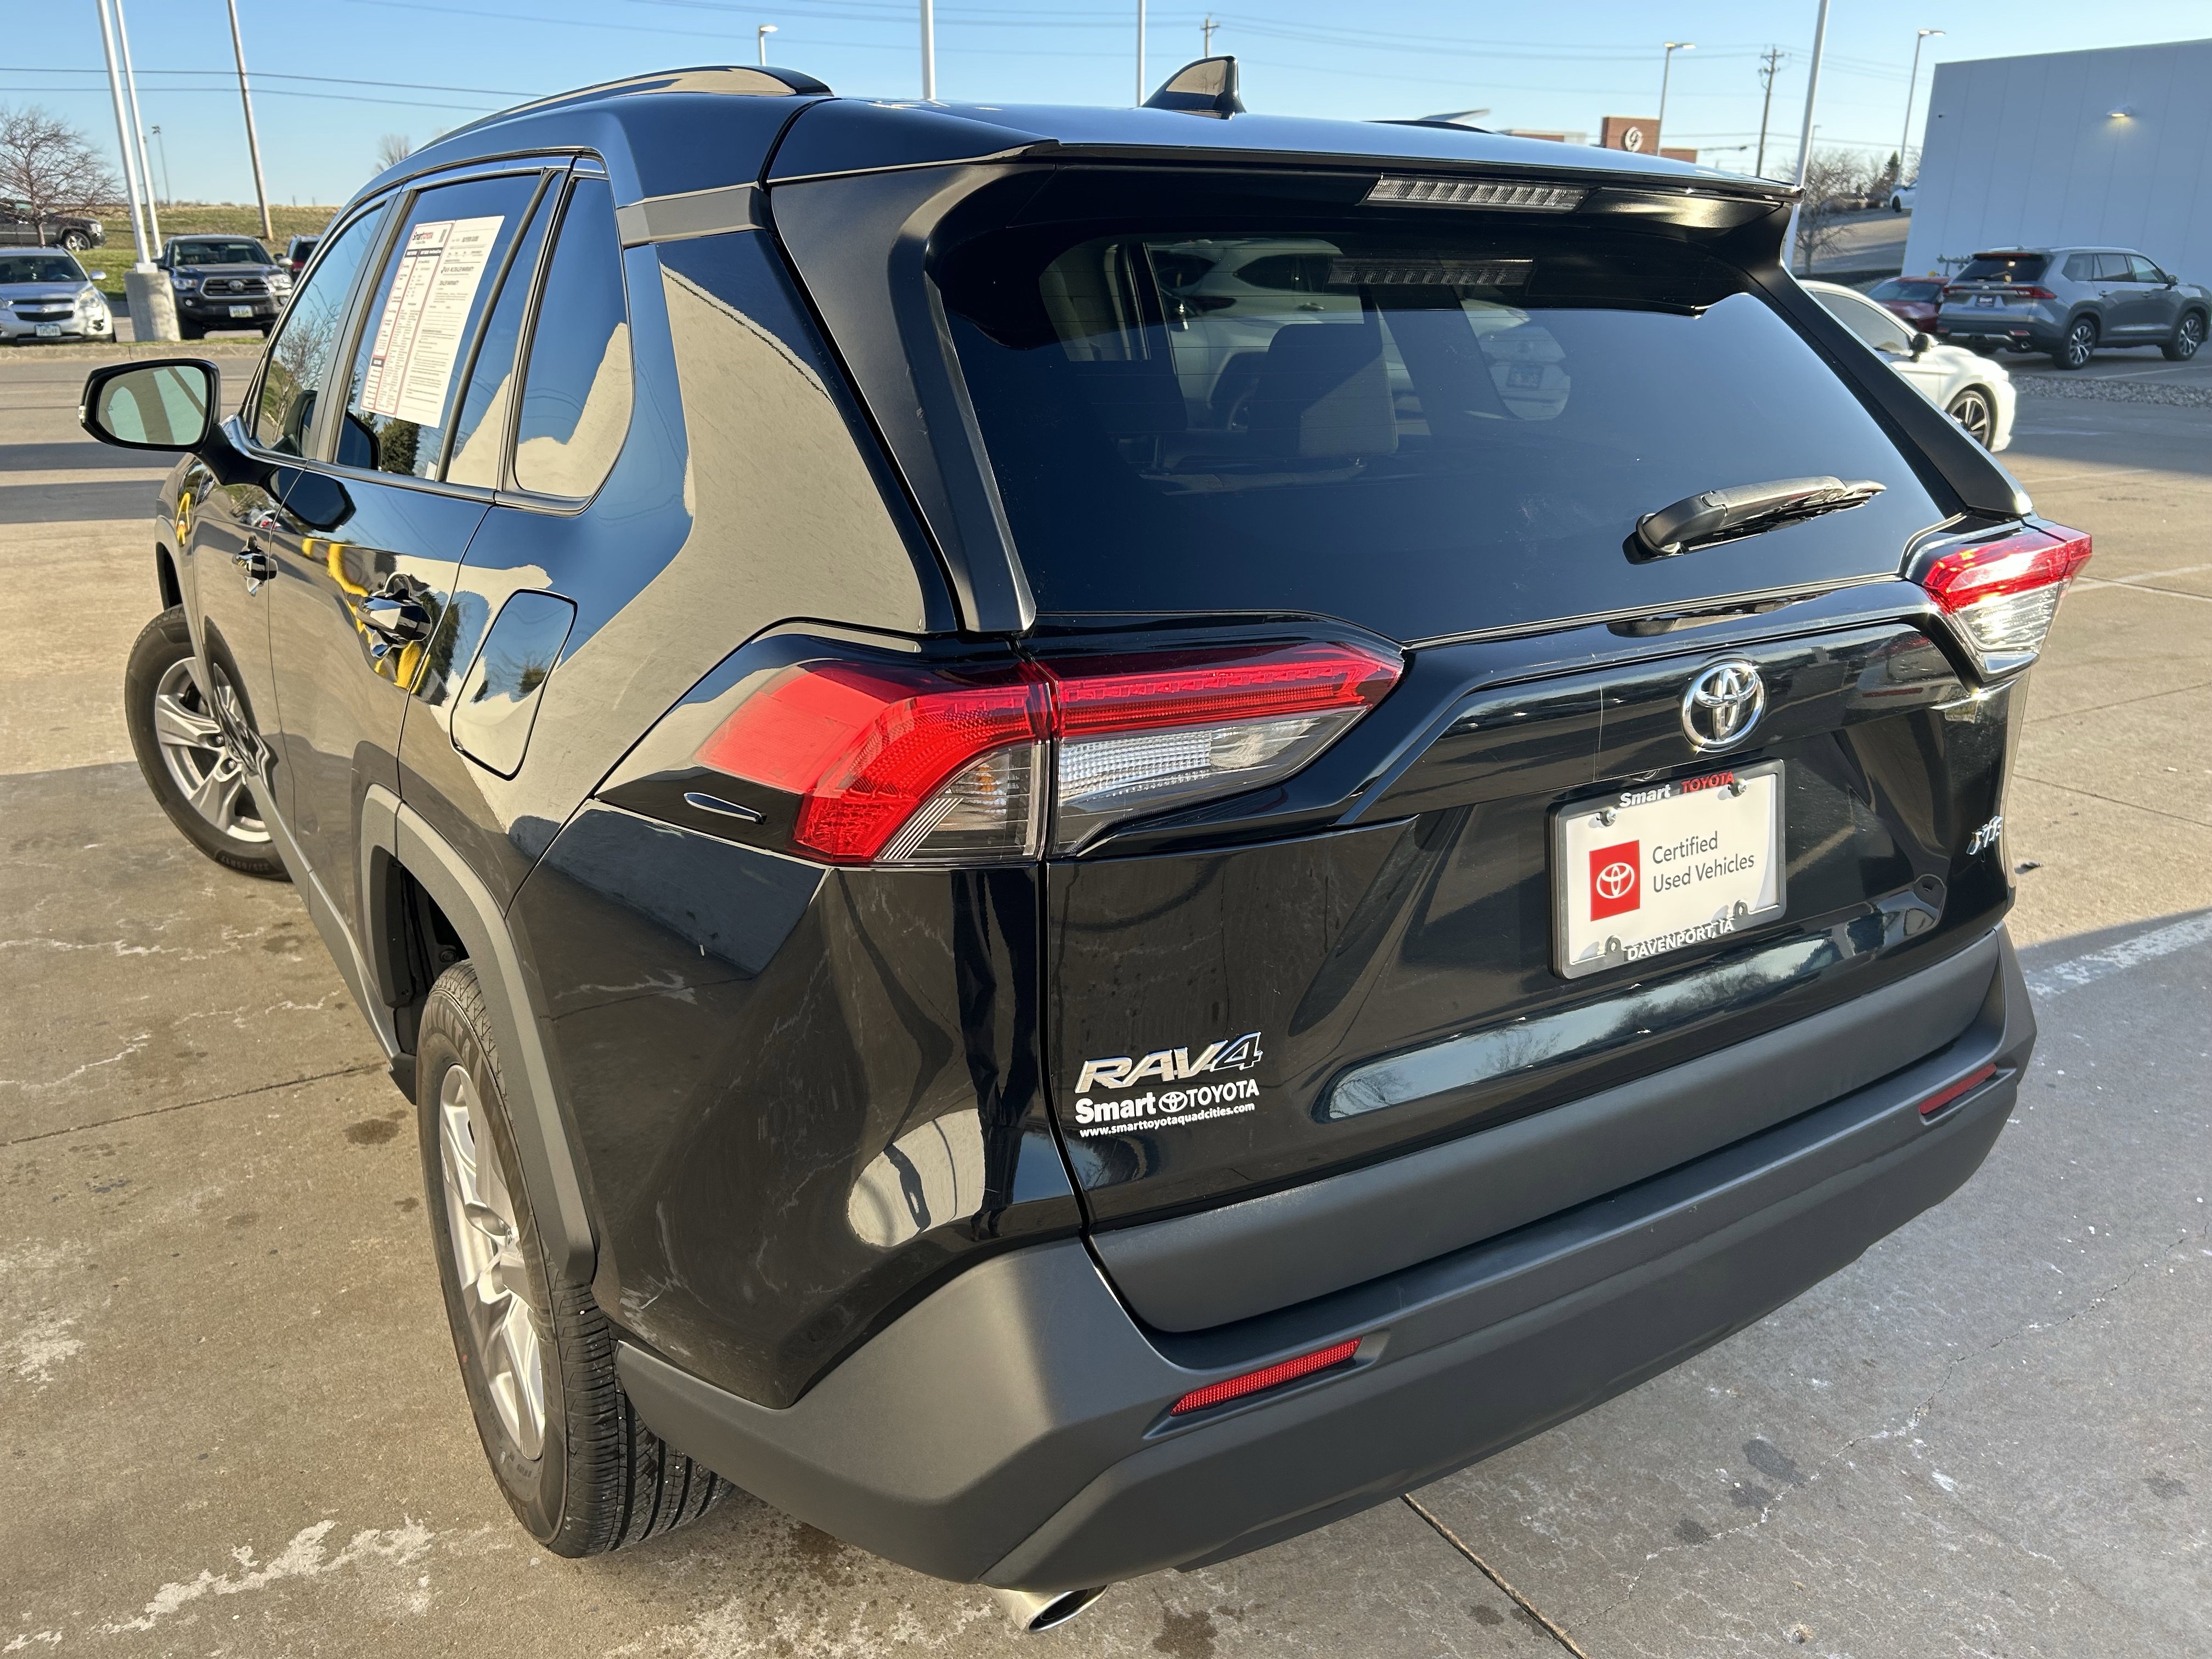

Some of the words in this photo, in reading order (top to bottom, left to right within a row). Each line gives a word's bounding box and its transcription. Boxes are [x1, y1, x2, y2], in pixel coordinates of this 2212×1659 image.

[1619, 784, 1671, 808] Smart
[1681, 771, 1735, 794] TOYOTA
[1652, 831, 1718, 864] Certified
[1653, 866, 1691, 893] Used
[1696, 853, 1754, 882] Vehicles
[1627, 924, 1716, 961] DAVENPORT,
[1718, 918, 1734, 934] IA
[1075, 1031, 1263, 1094] RAV4
[1075, 1092, 1156, 1124] Smart
[1186, 1078, 1260, 1108] TOYOTA
[1080, 1102, 1255, 1137] www.smarttoyotaquadcities.com
